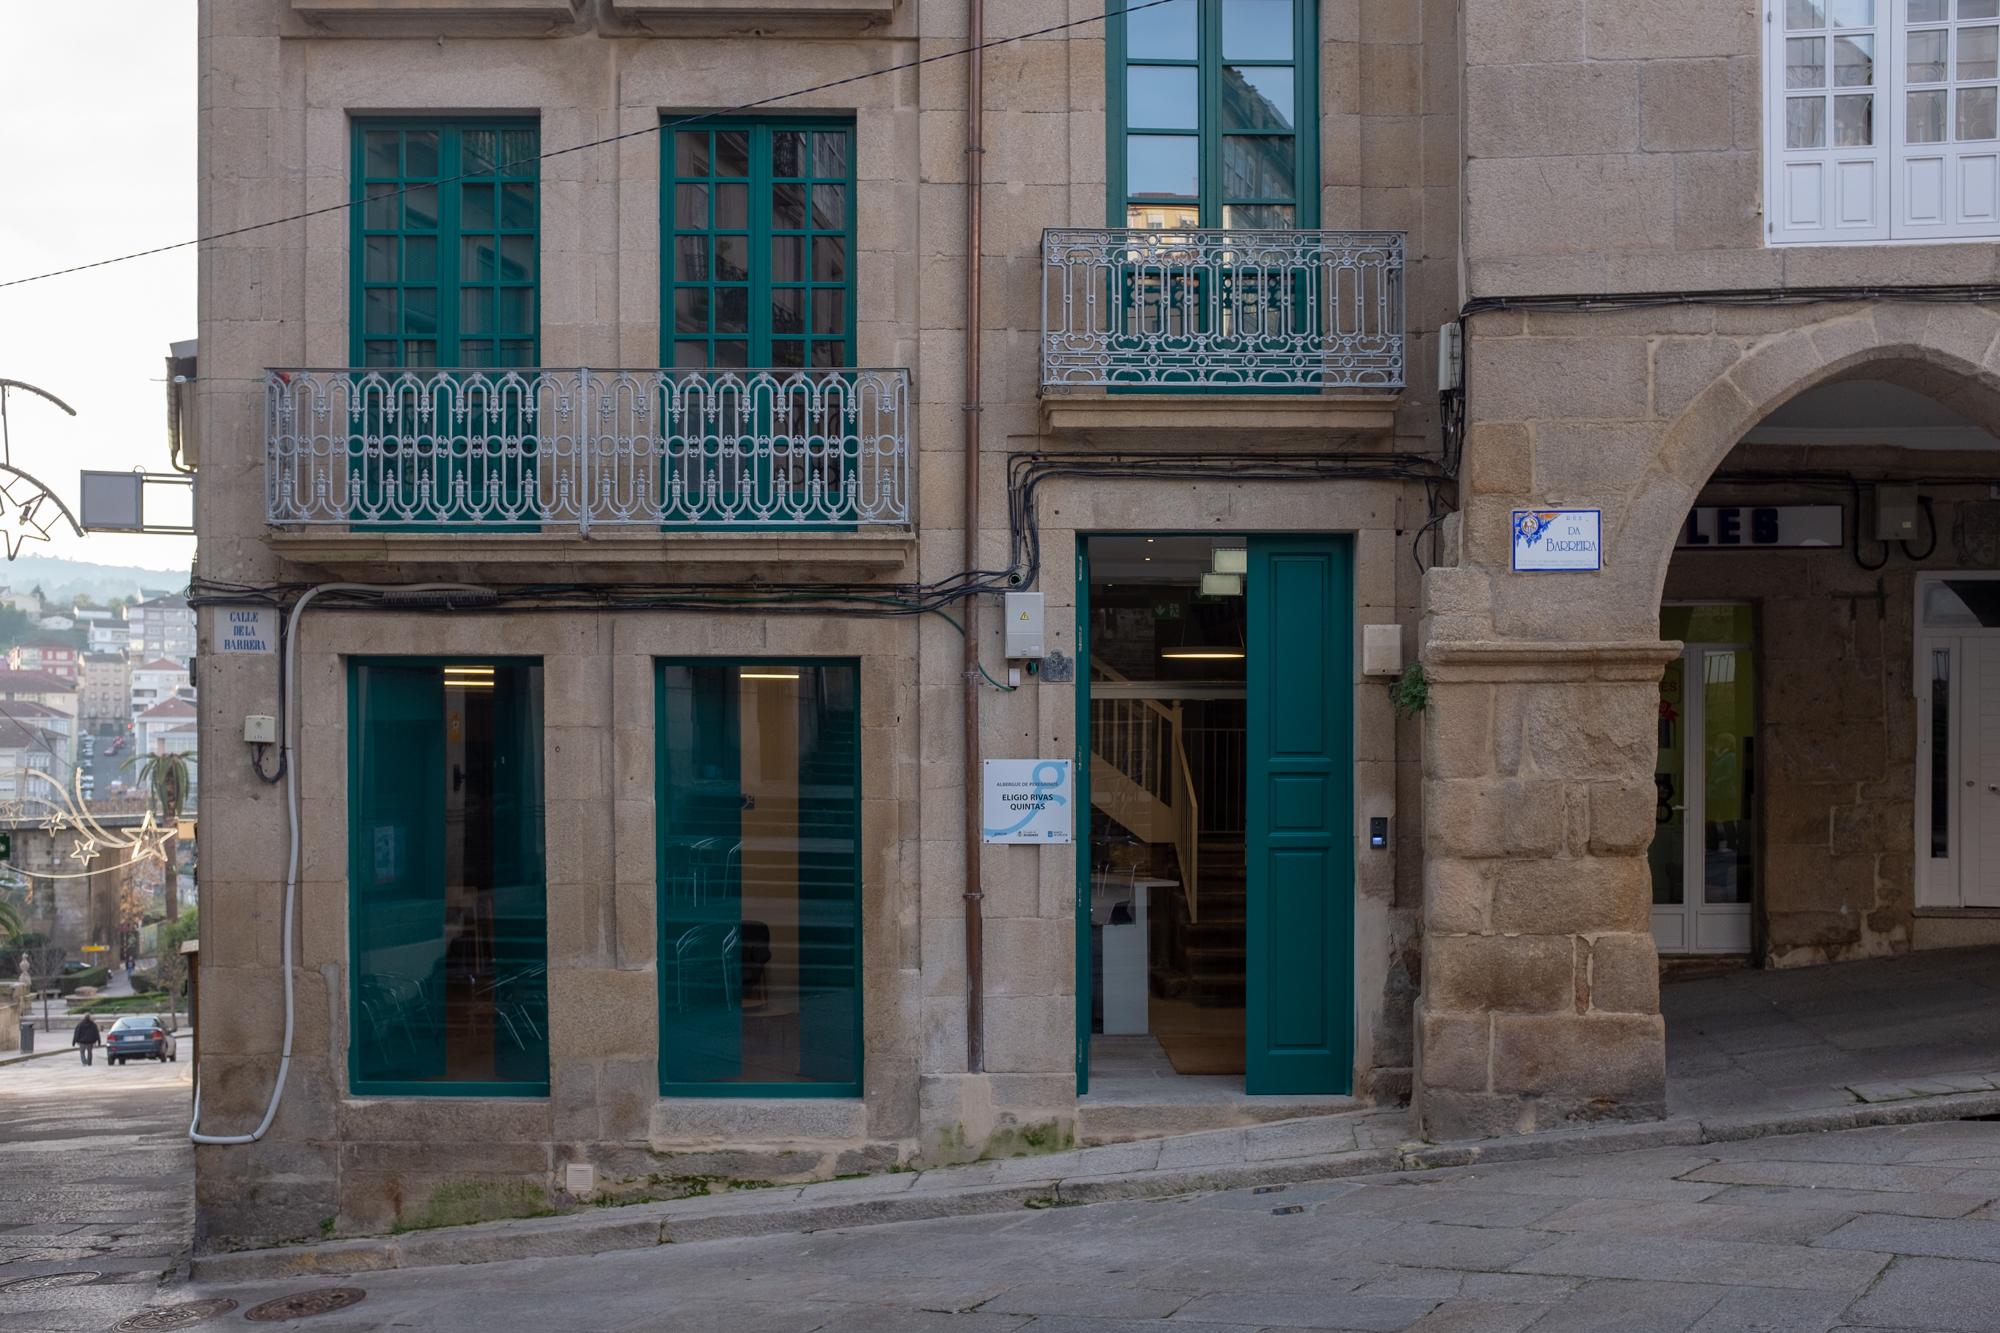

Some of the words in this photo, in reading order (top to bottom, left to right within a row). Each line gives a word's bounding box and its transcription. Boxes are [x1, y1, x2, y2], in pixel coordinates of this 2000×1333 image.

[1568, 526, 1581, 536] DA
[1546, 538, 1597, 552] BARREIRA
[230, 611, 259, 623] CALLE
[224, 639, 266, 650] BARRERA
[1002, 793, 1028, 801] ELIGIO
[1030, 793, 1054, 801] RIVAS
[1010, 803, 1046, 811] QUINTAS
